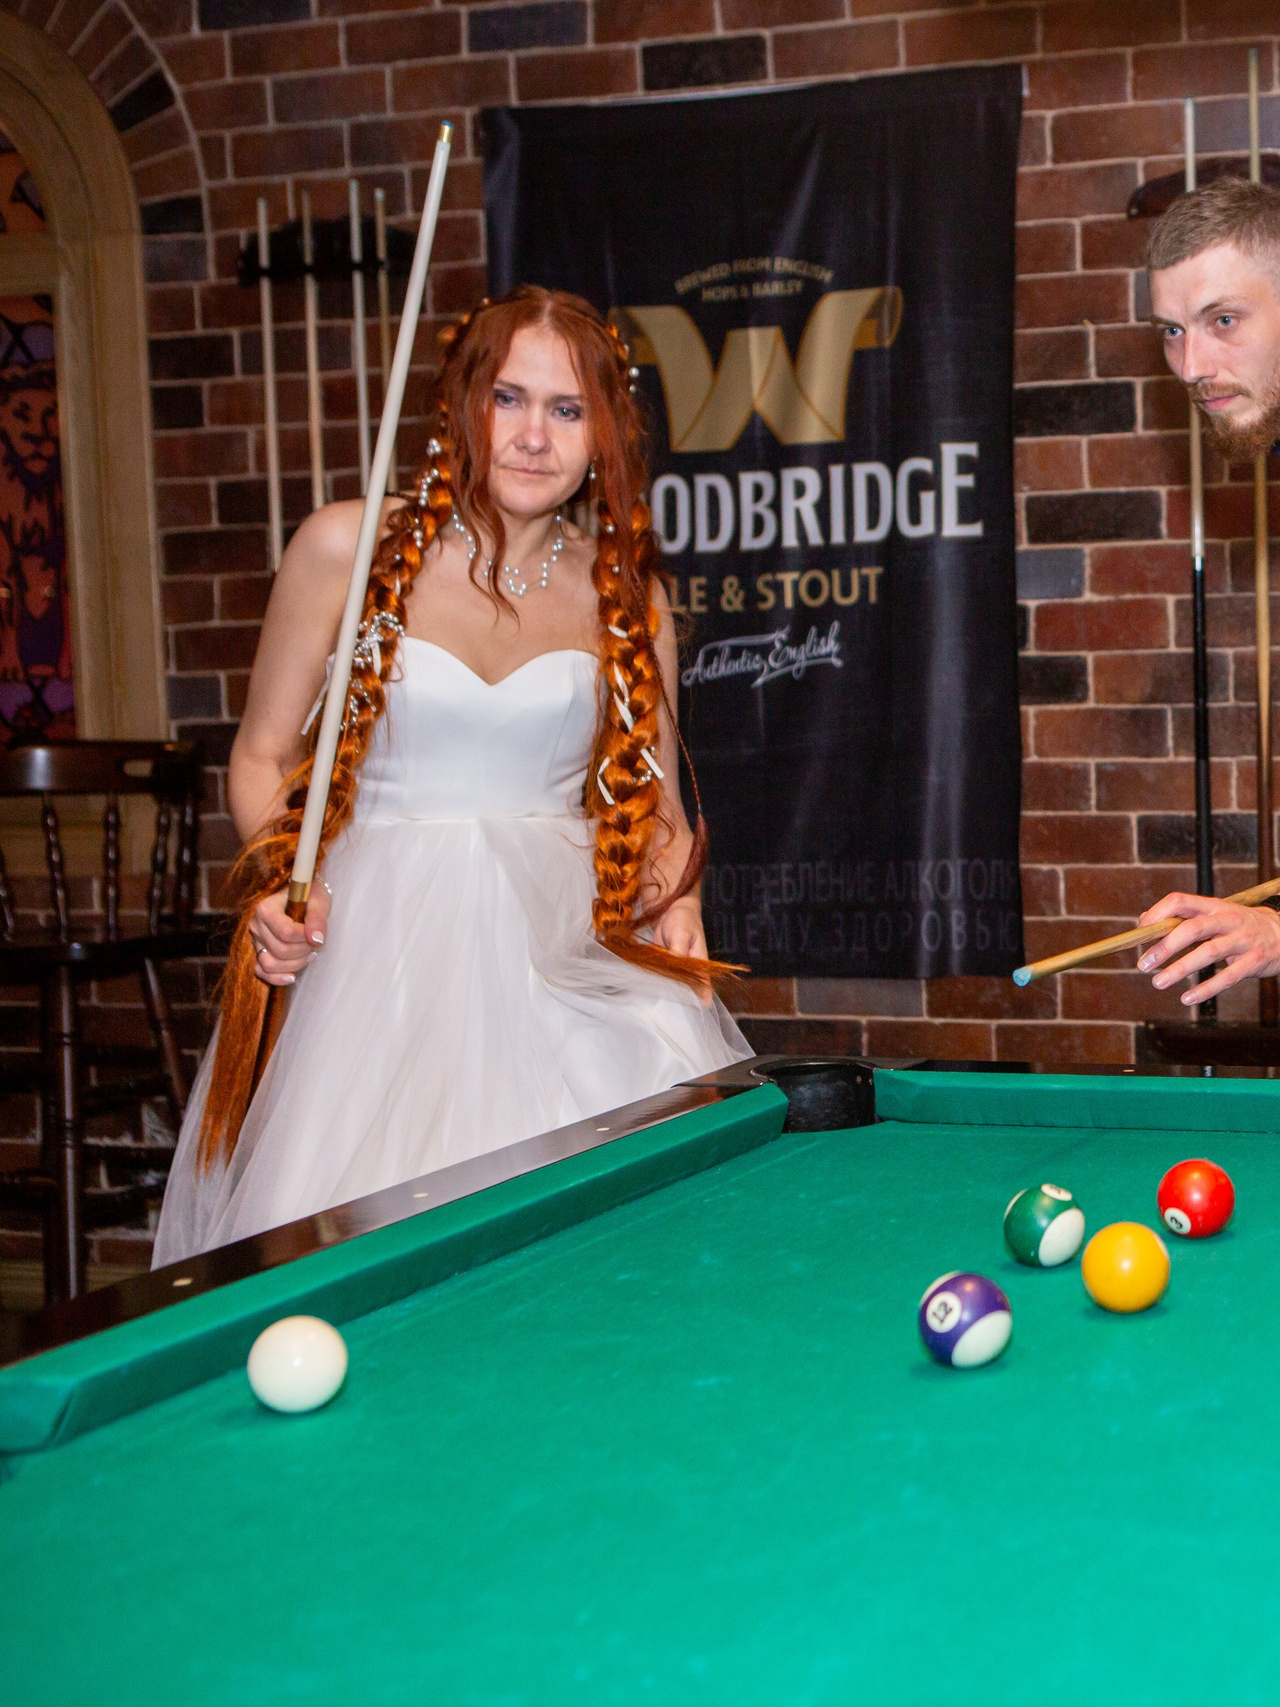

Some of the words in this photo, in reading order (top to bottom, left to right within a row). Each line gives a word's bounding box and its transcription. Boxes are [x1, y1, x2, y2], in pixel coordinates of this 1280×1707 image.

[650, 442, 984, 555] ODBRIDGE
[669, 575, 709, 614] LE
[720, 575, 745, 613] &
[756, 566, 885, 611] STOUT
[681, 632, 771, 688] Authentic
[766, 620, 844, 682] English
[702, 860, 876, 904] ПОТРЕБЛЕНИЕ
[713, 911, 813, 955] ШЕМУ
[1169, 1215, 1184, 1230] 3
[932, 1301, 953, 1325] 12
